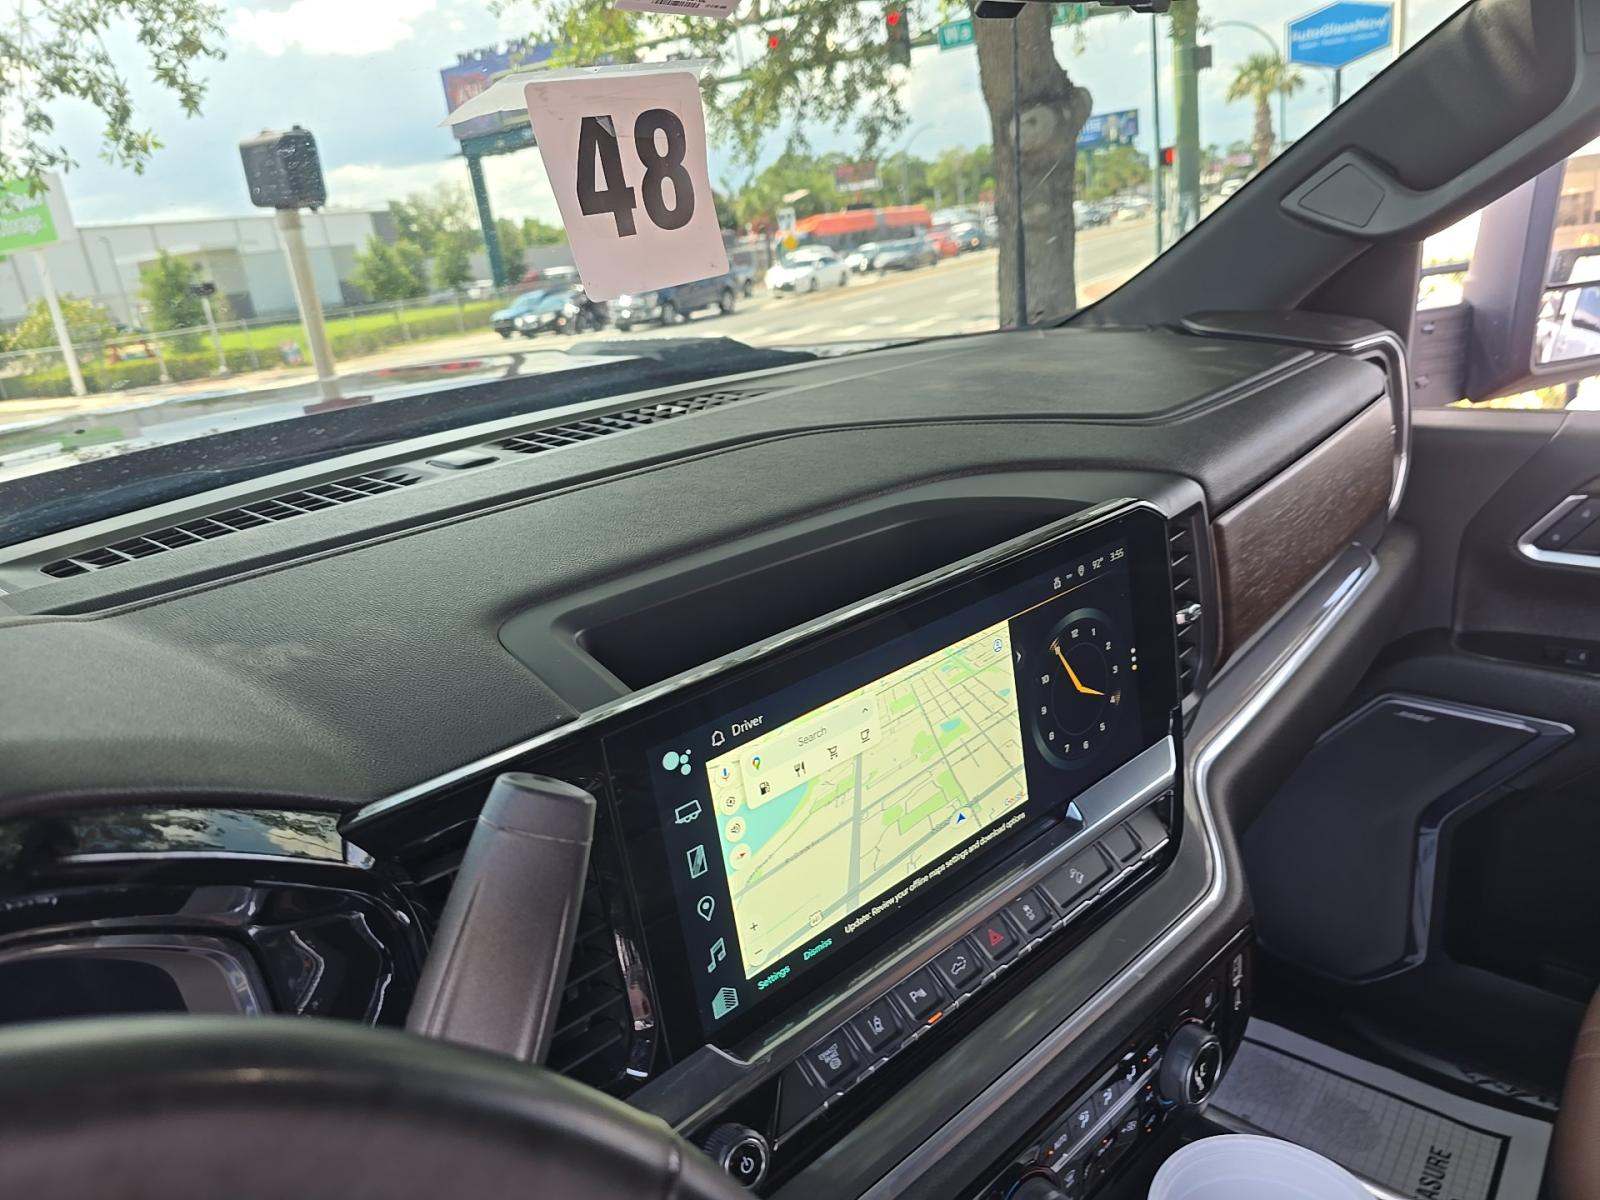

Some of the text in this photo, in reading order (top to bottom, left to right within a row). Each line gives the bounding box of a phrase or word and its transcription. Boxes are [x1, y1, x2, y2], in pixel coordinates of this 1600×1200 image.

[576, 108, 695, 238] 48
[1105, 641, 1111, 650] 2
[731, 715, 764, 737] Driver
[798, 726, 827, 747] Search
[844, 812, 1026, 933] Update: Review your offline maps settings and download options
[803, 938, 833, 960] Dismiss
[757, 965, 791, 990] Settings
[1408, 1145, 1452, 1200] ASURE
